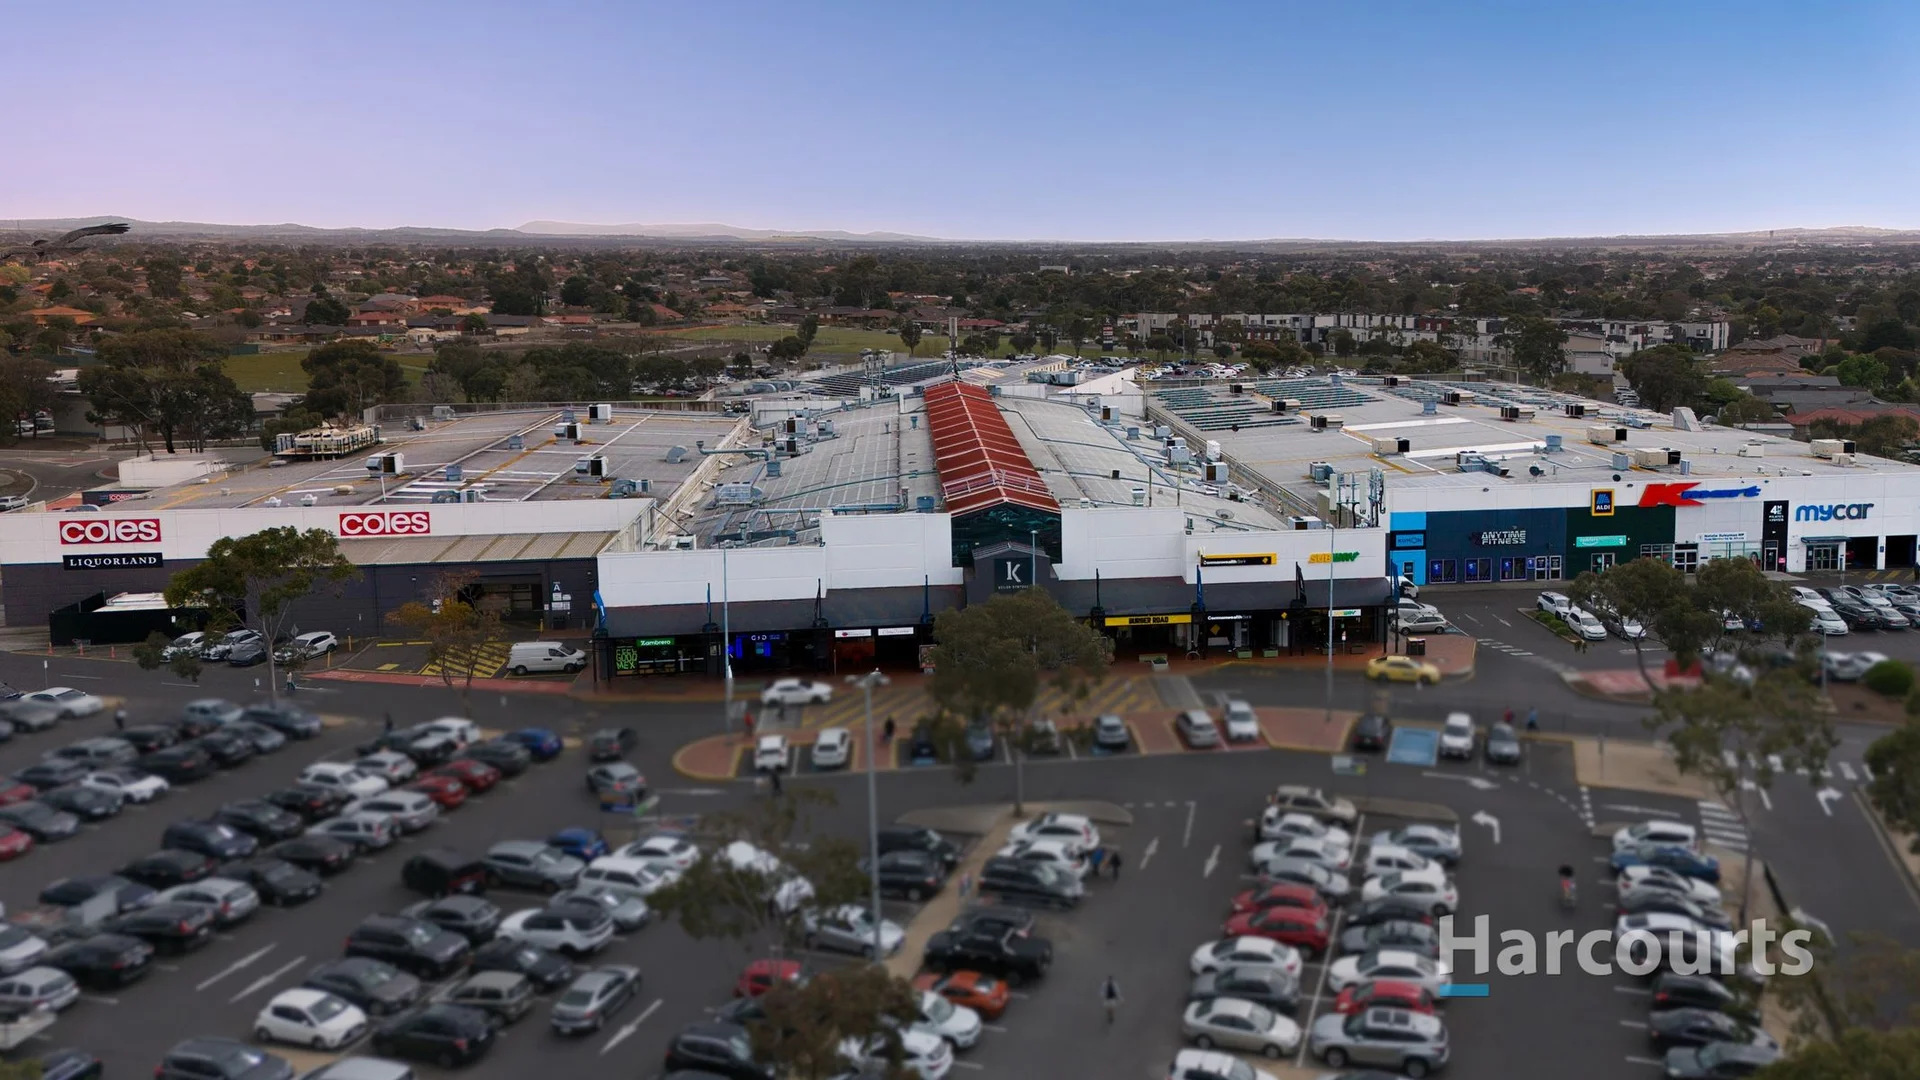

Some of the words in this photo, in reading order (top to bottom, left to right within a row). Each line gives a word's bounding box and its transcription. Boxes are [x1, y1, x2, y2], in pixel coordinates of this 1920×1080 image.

[1795, 503, 1874, 522] mycar
[341, 512, 429, 535] coles
[61, 520, 159, 543] coles
[1481, 530, 1526, 538] ANYTIME
[70, 556, 156, 568] LIQUORLAND
[1129, 616, 1151, 625] BURGER
[1152, 616, 1169, 624] ROAD
[616, 654, 638, 662] GOOD
[616, 661, 636, 670] MEX
